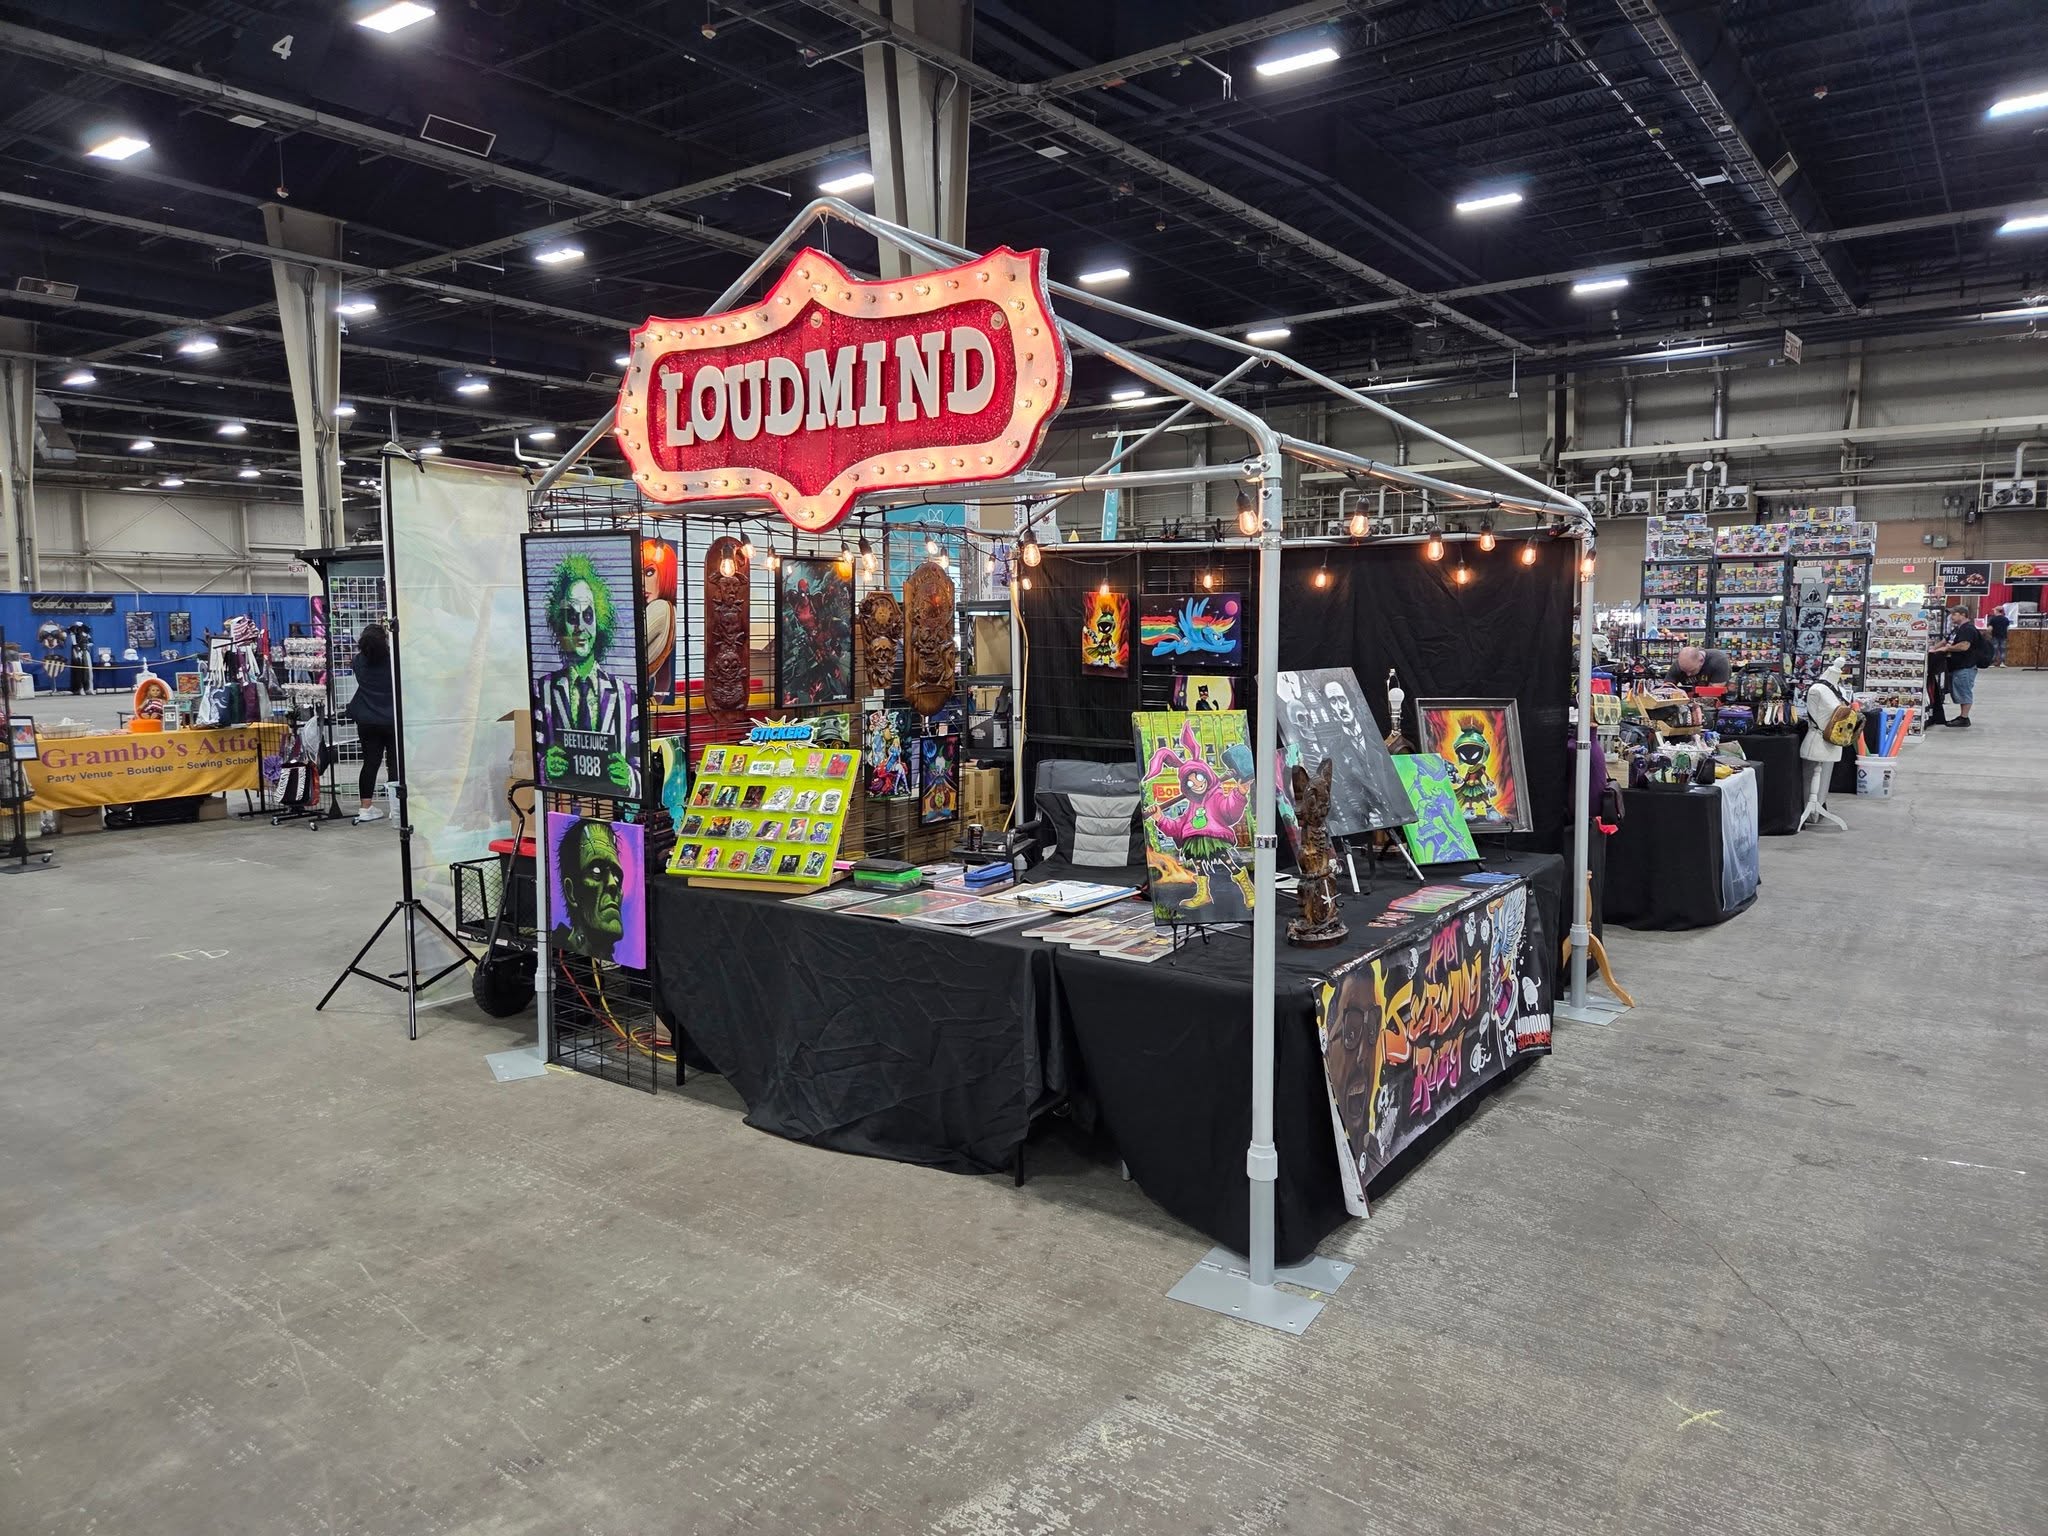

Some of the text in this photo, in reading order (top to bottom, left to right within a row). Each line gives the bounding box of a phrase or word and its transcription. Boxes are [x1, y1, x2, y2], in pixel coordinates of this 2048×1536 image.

[271, 34, 294, 60] 4
[661, 326, 996, 447] LOUDMIND
[291, 565, 306, 573] EXIT
[1875, 557, 1912, 565] EMERGENCY
[1942, 566, 1966, 575] PRETZEL
[32, 601, 113, 609] COSPLAY MUSEUM
[563, 733, 609, 752] BEETLEJUICE
[751, 725, 812, 741] STICKERS
[41, 739, 189, 769] Grambo's
[196, 734, 259, 755] Attic
[47, 773, 76, 783] Party
[80, 770, 113, 780] Venue
[127, 764, 174, 776] Boutique
[187, 758, 223, 770] Sewing
[226, 755, 257, 766] School
[573, 755, 601, 777] 1988
